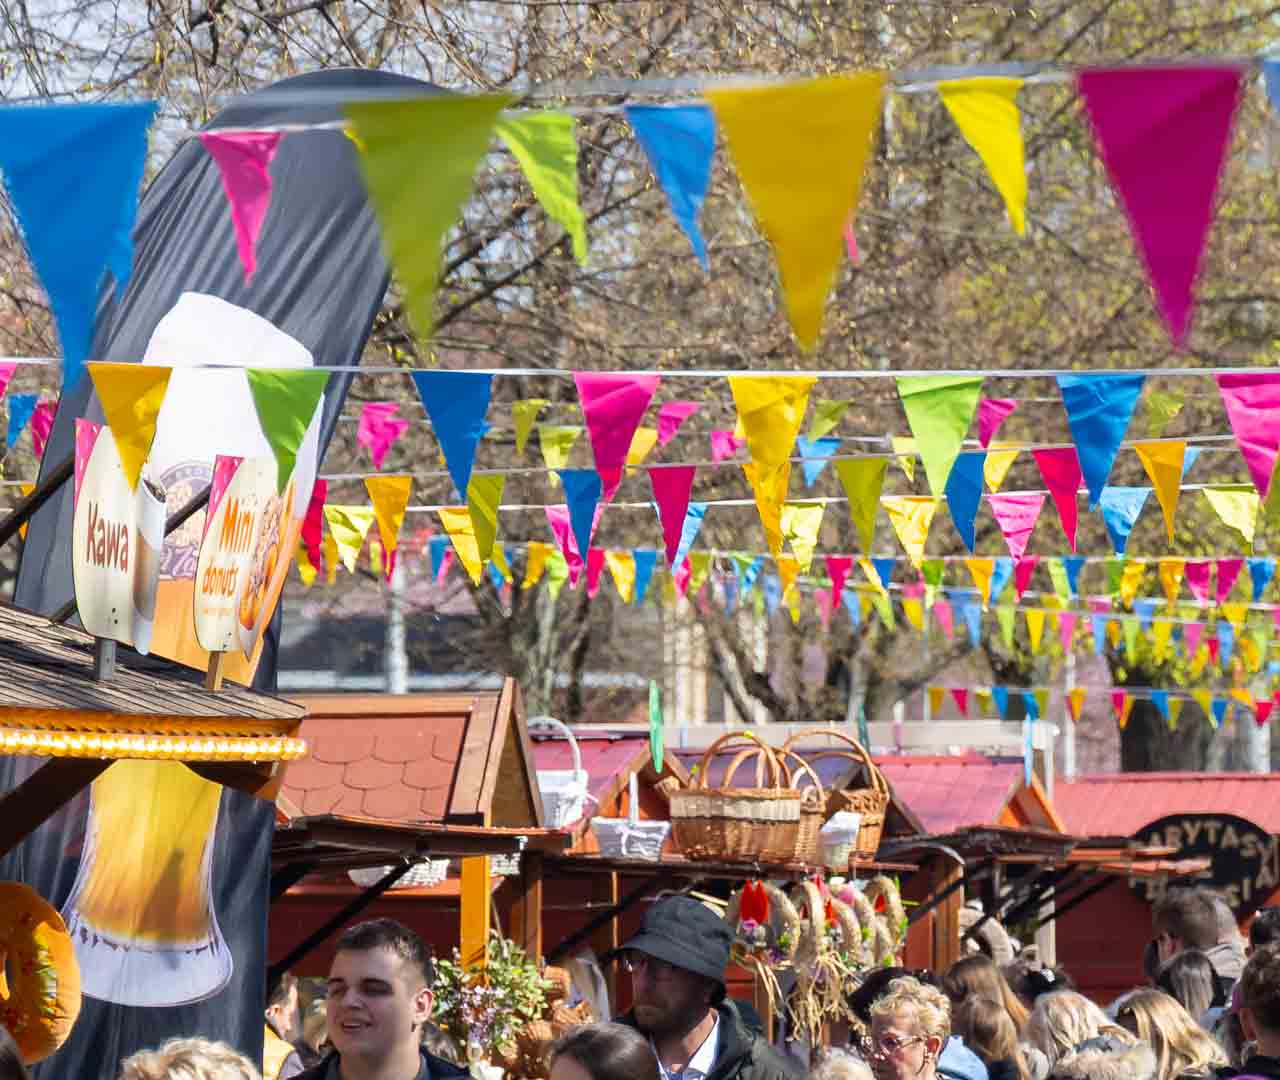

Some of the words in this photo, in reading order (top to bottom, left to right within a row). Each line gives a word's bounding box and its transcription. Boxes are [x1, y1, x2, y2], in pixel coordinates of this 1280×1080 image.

[86, 500, 128, 575] Kawa
[219, 496, 255, 552] Mini
[202, 558, 238, 598] donuts
[1129, 819, 1278, 865] ARYTASY
